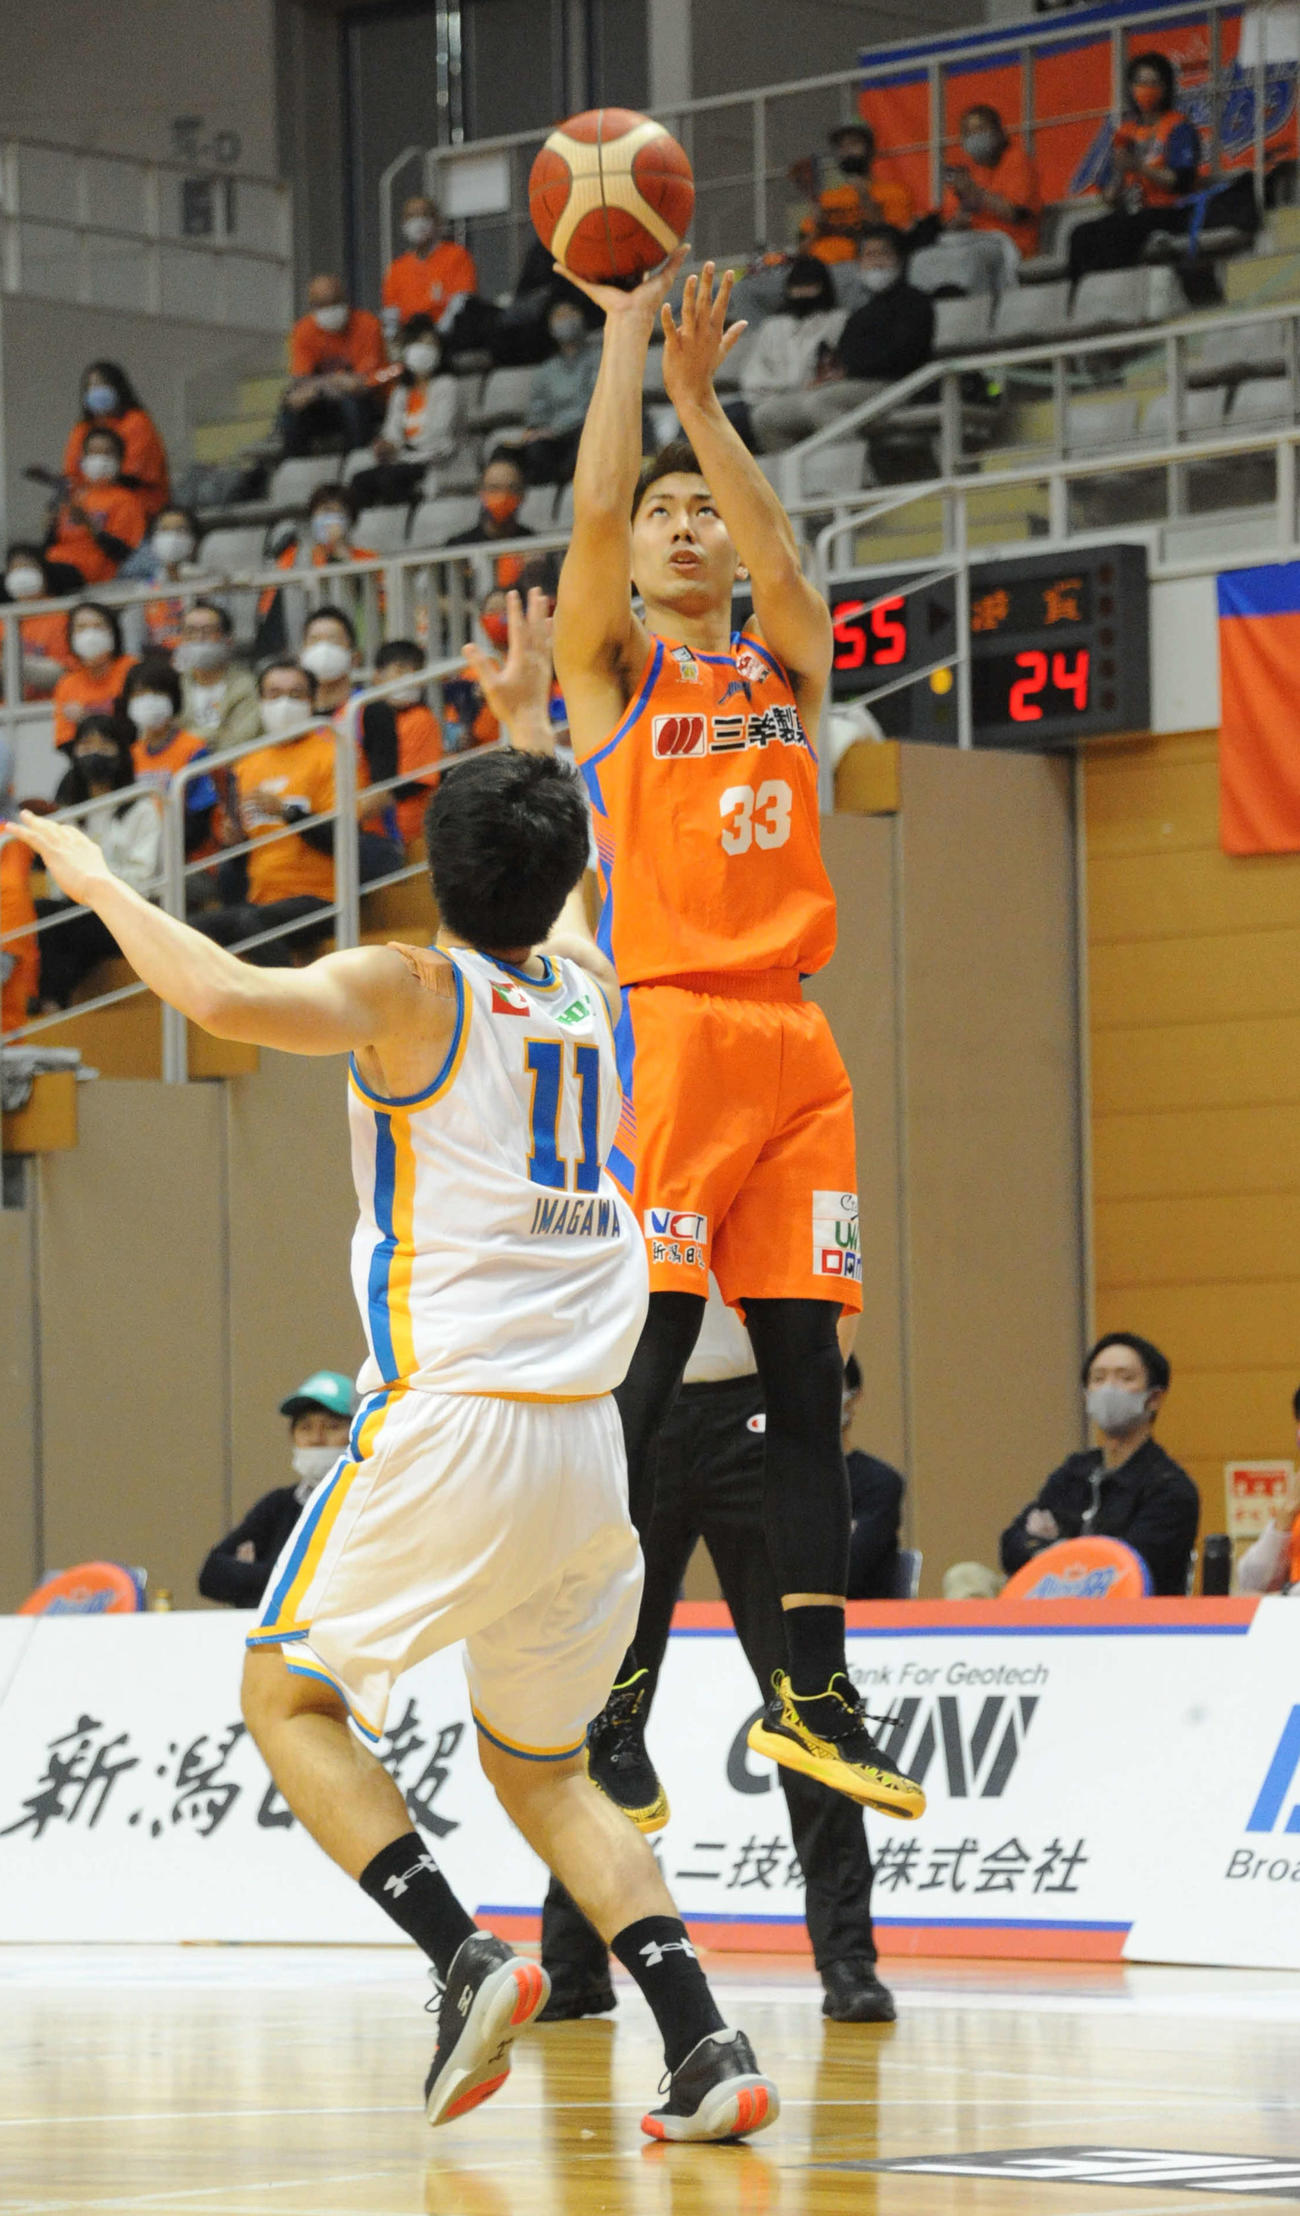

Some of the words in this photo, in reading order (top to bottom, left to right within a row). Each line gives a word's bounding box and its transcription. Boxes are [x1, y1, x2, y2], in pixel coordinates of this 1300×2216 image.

[1009, 650, 1090, 722] 24
[719, 779, 793, 857] 33
[523, 1036, 602, 1195] 11
[530, 1197, 621, 1239] IMAGAWA
[899, 1662, 940, 1685] For
[946, 1661, 1049, 1686] Geotech
[0, 1698, 465, 1840] 新潟報
